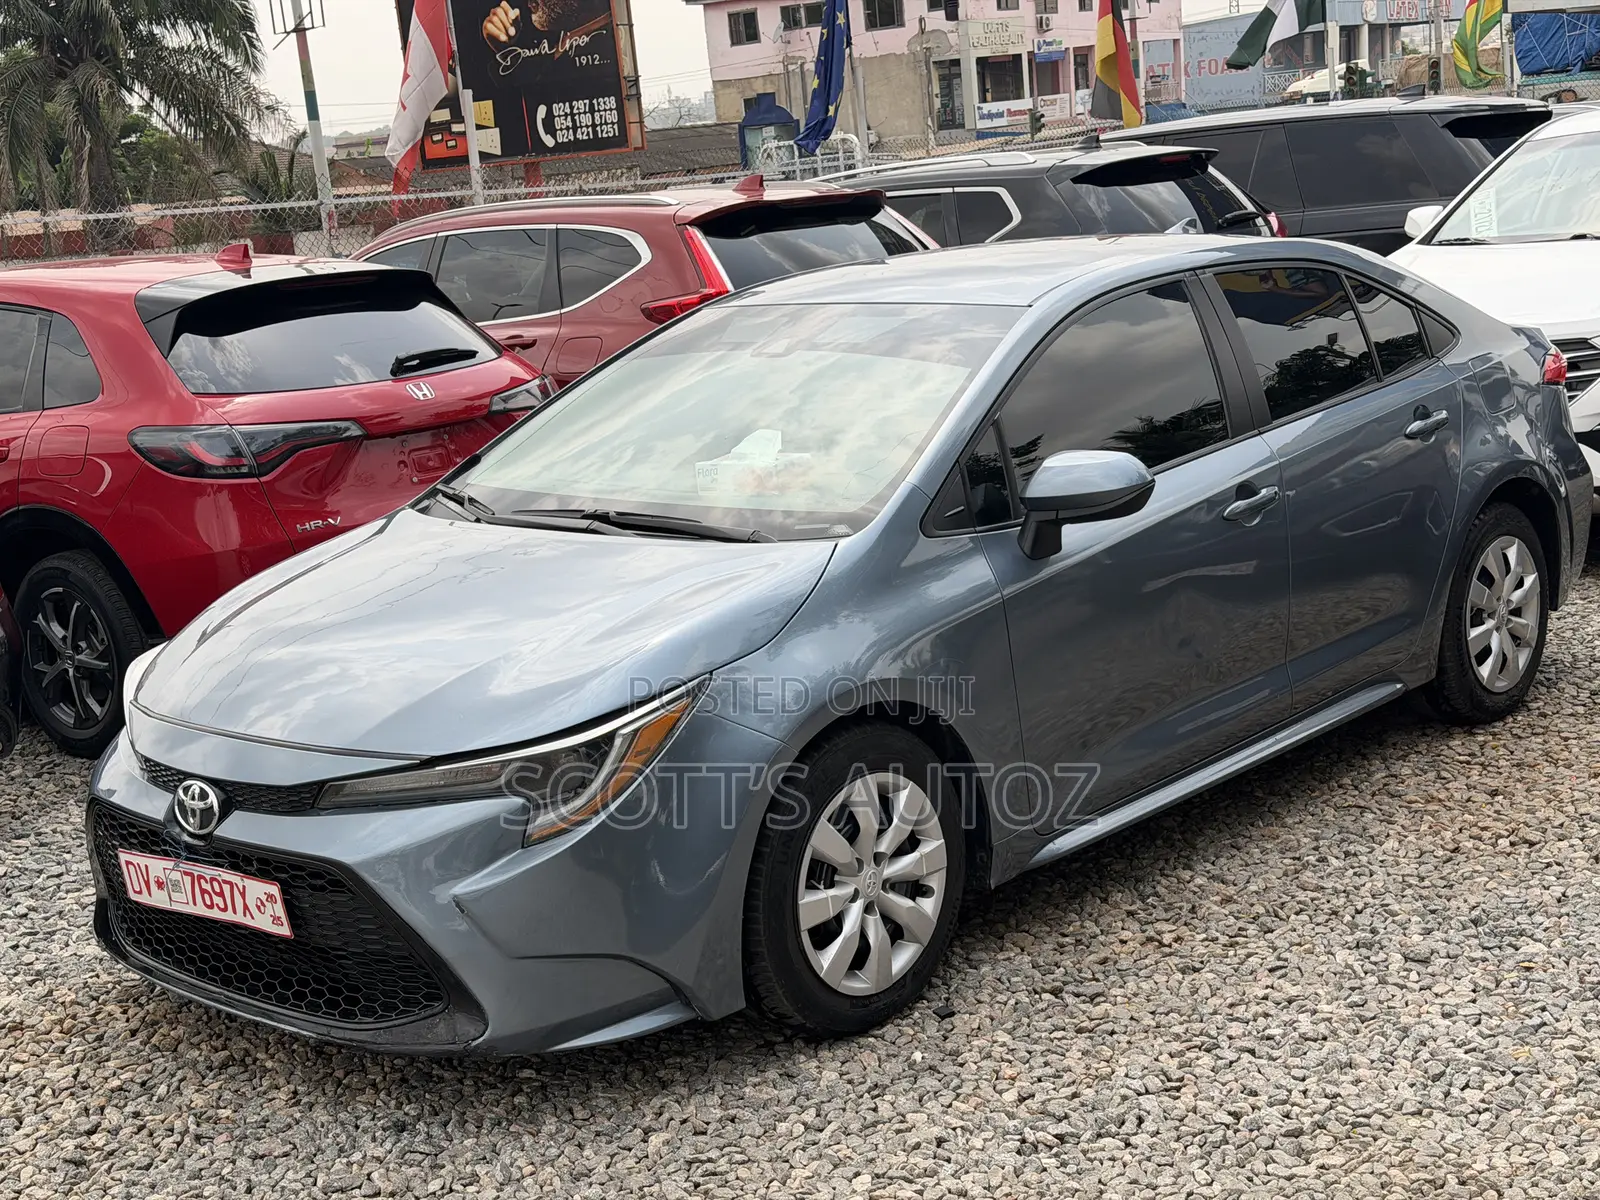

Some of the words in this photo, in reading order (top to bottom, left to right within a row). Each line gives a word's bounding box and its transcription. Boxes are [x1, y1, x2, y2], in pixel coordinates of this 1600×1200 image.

[1388, 1, 1420, 18] LATEX
[553, 102, 571, 116] 024
[572, 99, 591, 114] 297
[593, 96, 617, 111] 1338
[554, 116, 573, 130] 054
[574, 113, 592, 127] 190
[594, 109, 618, 124] 8760
[556, 129, 574, 143] 024
[576, 127, 594, 140] 421
[595, 123, 619, 138] 1251
[697, 467, 719, 479] Flora
[296, 516, 341, 533] HR-V
[124, 860, 153, 898] DV
[183, 870, 256, 921] 7697X
